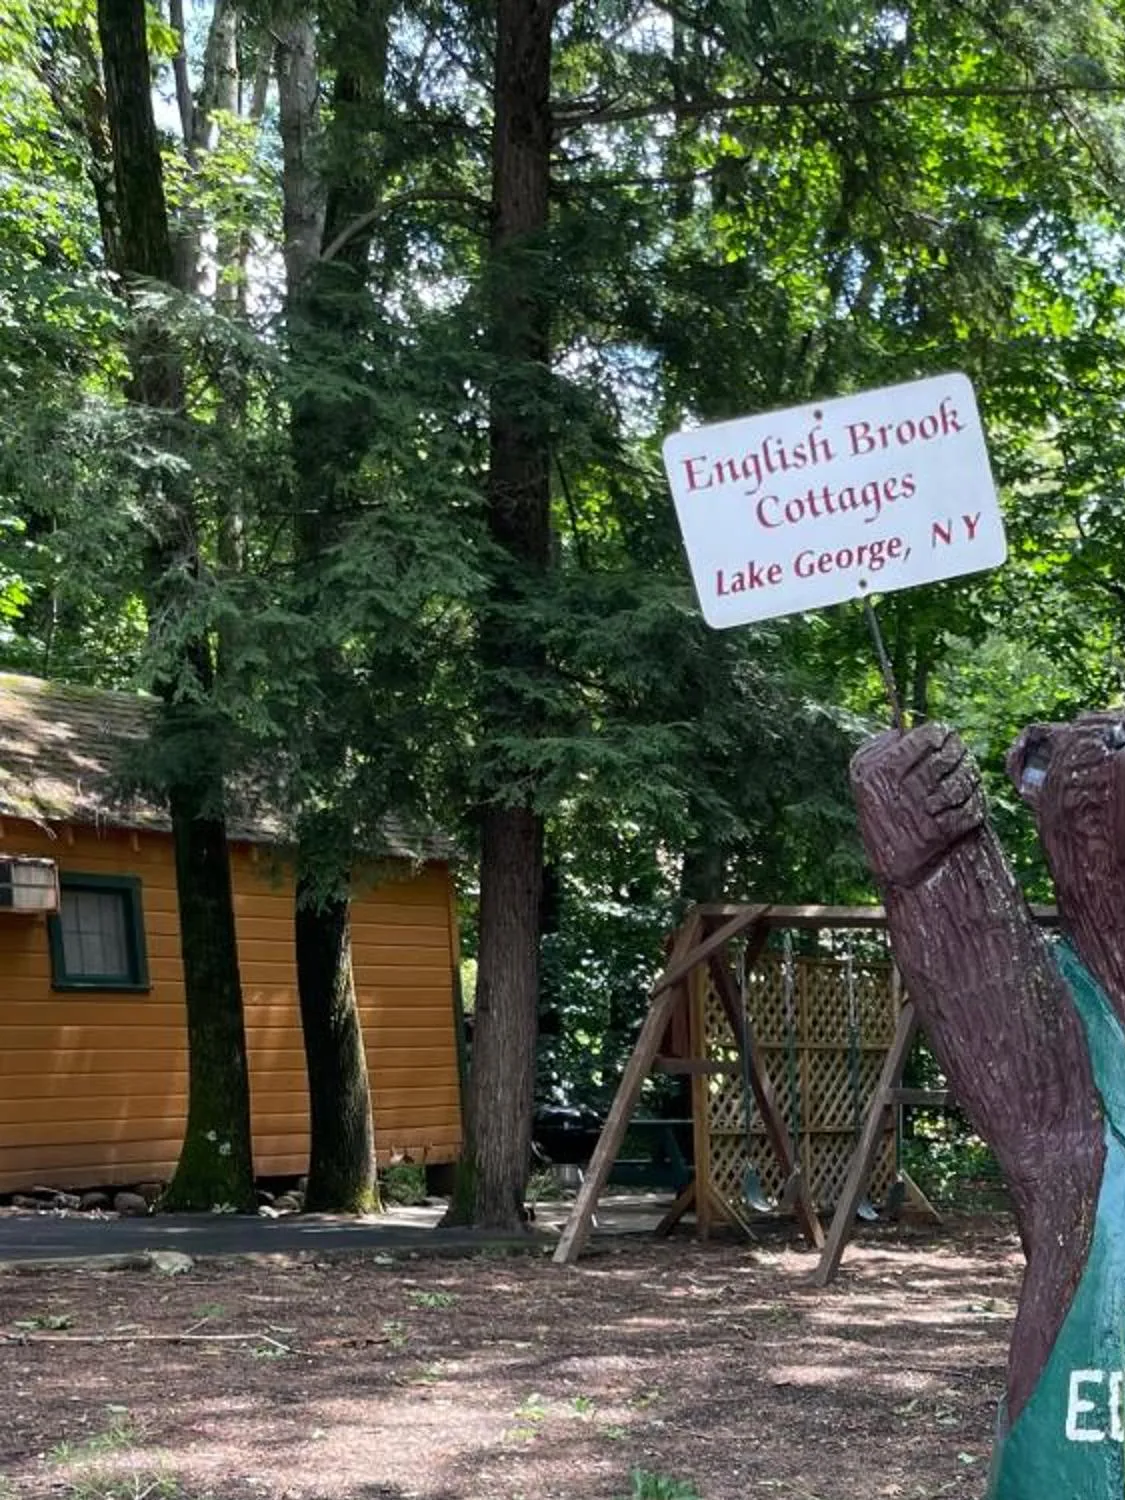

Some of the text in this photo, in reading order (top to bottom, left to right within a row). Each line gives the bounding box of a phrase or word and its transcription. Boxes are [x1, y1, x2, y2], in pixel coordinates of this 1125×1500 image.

[681, 396, 967, 495] English Brook
[756, 472, 917, 529] Cottages
[715, 511, 982, 597] Lake George, NY
